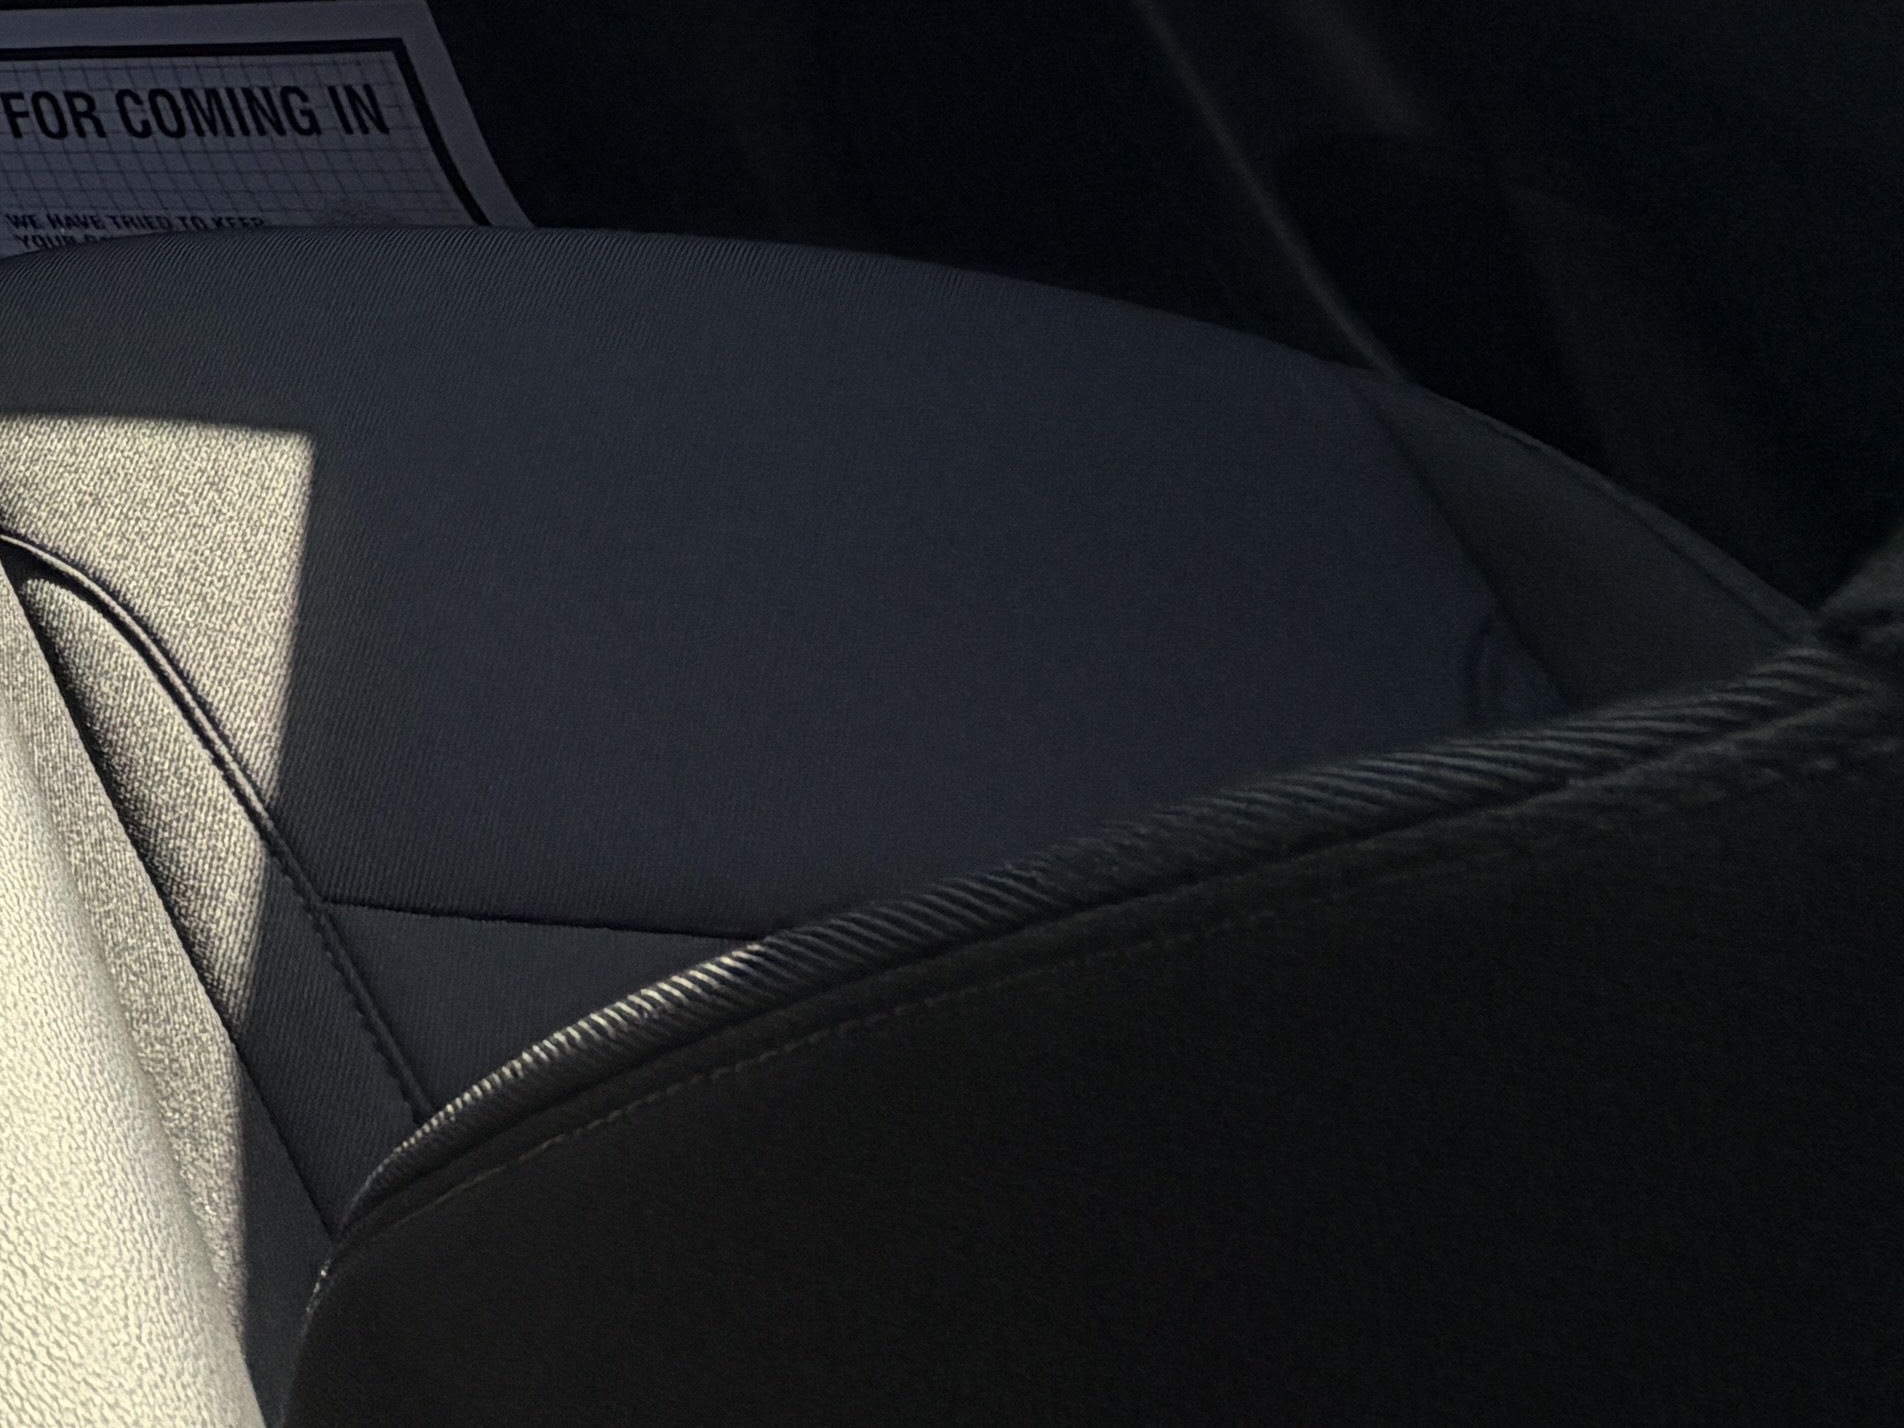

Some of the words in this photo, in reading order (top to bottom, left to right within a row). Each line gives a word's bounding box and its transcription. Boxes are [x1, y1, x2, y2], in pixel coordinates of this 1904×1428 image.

[115, 85, 321, 141] COMING
[325, 82, 393, 136] IN
[5, 214, 41, 229] WE
[46, 214, 105, 230] HAVE
[107, 214, 174, 231] TRIED
[175, 215, 208, 231] TO
